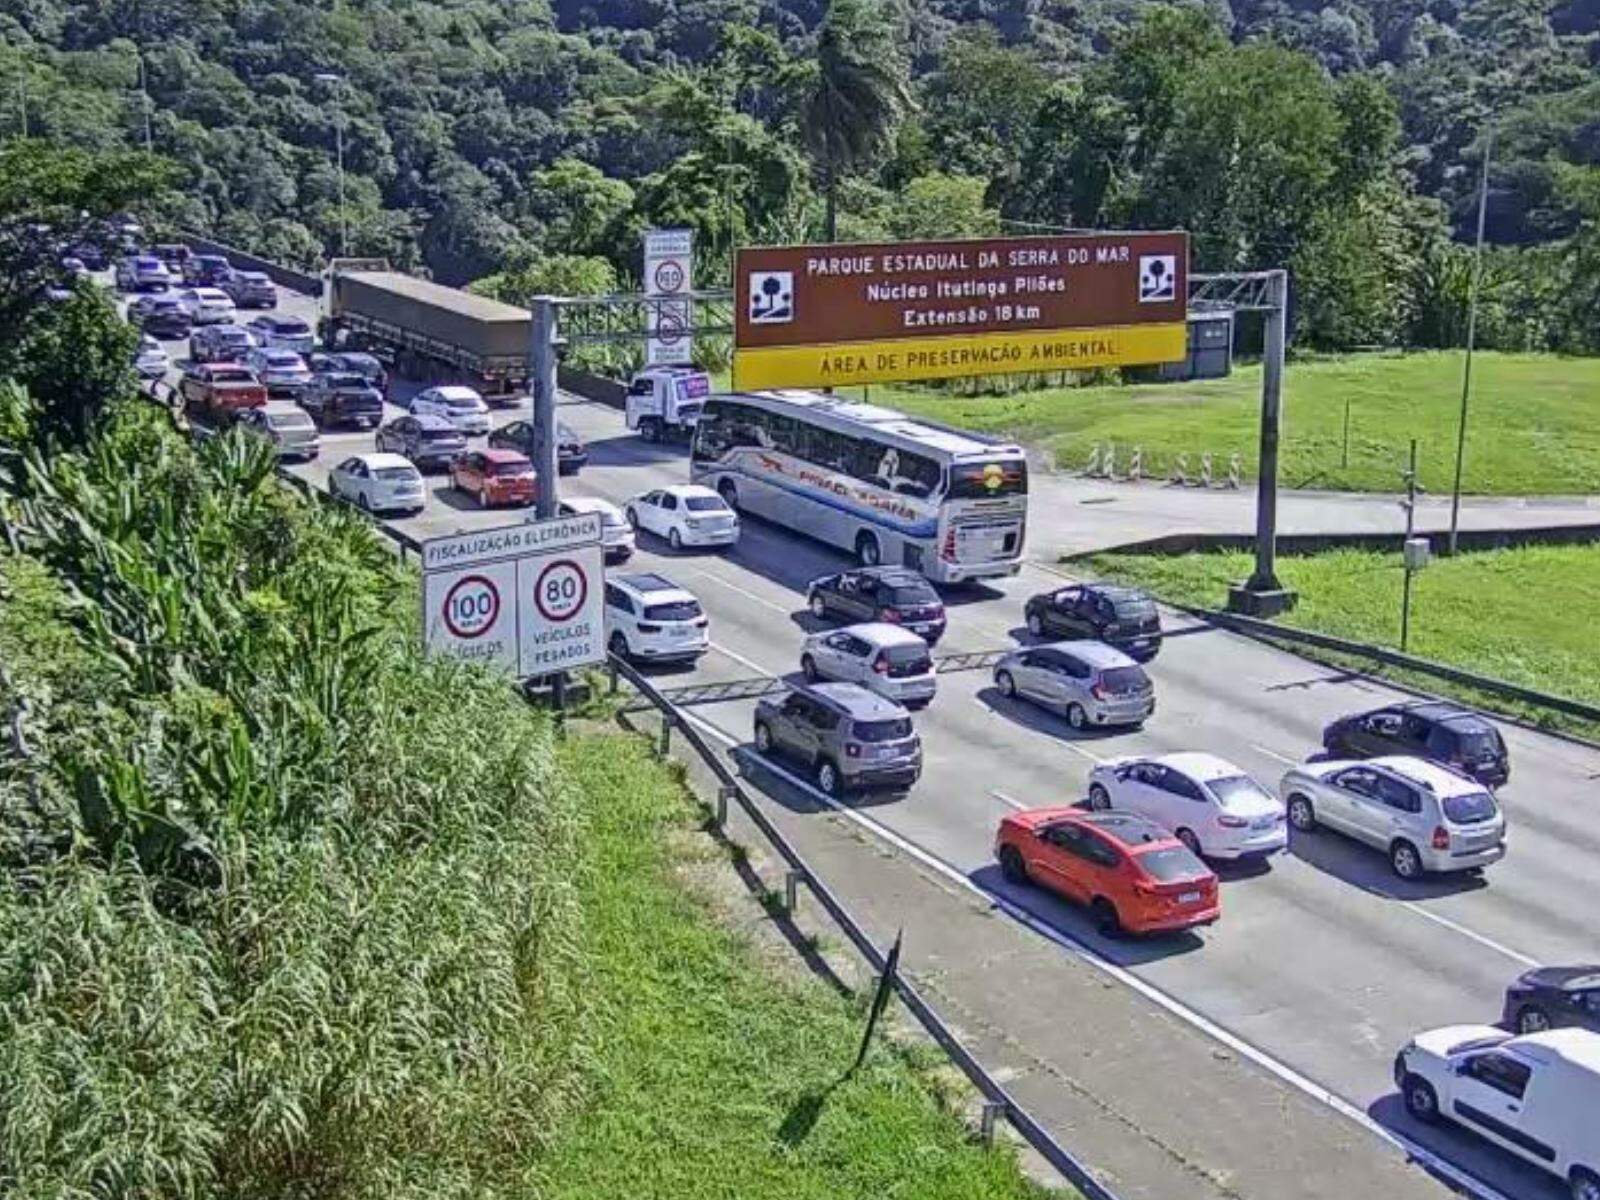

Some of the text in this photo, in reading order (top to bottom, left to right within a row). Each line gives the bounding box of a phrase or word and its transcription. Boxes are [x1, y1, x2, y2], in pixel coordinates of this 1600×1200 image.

[807, 246, 1130, 276] PARQUE ESTADUAL DA SERRA DO MAR
[868, 276, 1066, 302] Núcleo Itutinga Pilões
[904, 304, 1040, 327] Extensão 18 km
[819, 340, 1116, 376] ÁREA DE PRESERVAÇÃO AMBIENTAL
[428, 521, 597, 562] FISCALIZAÇÃO ELETRÔNICA
[546, 576, 577, 602] 80
[452, 592, 492, 620] 100
[535, 643, 591, 664] PESADOS
